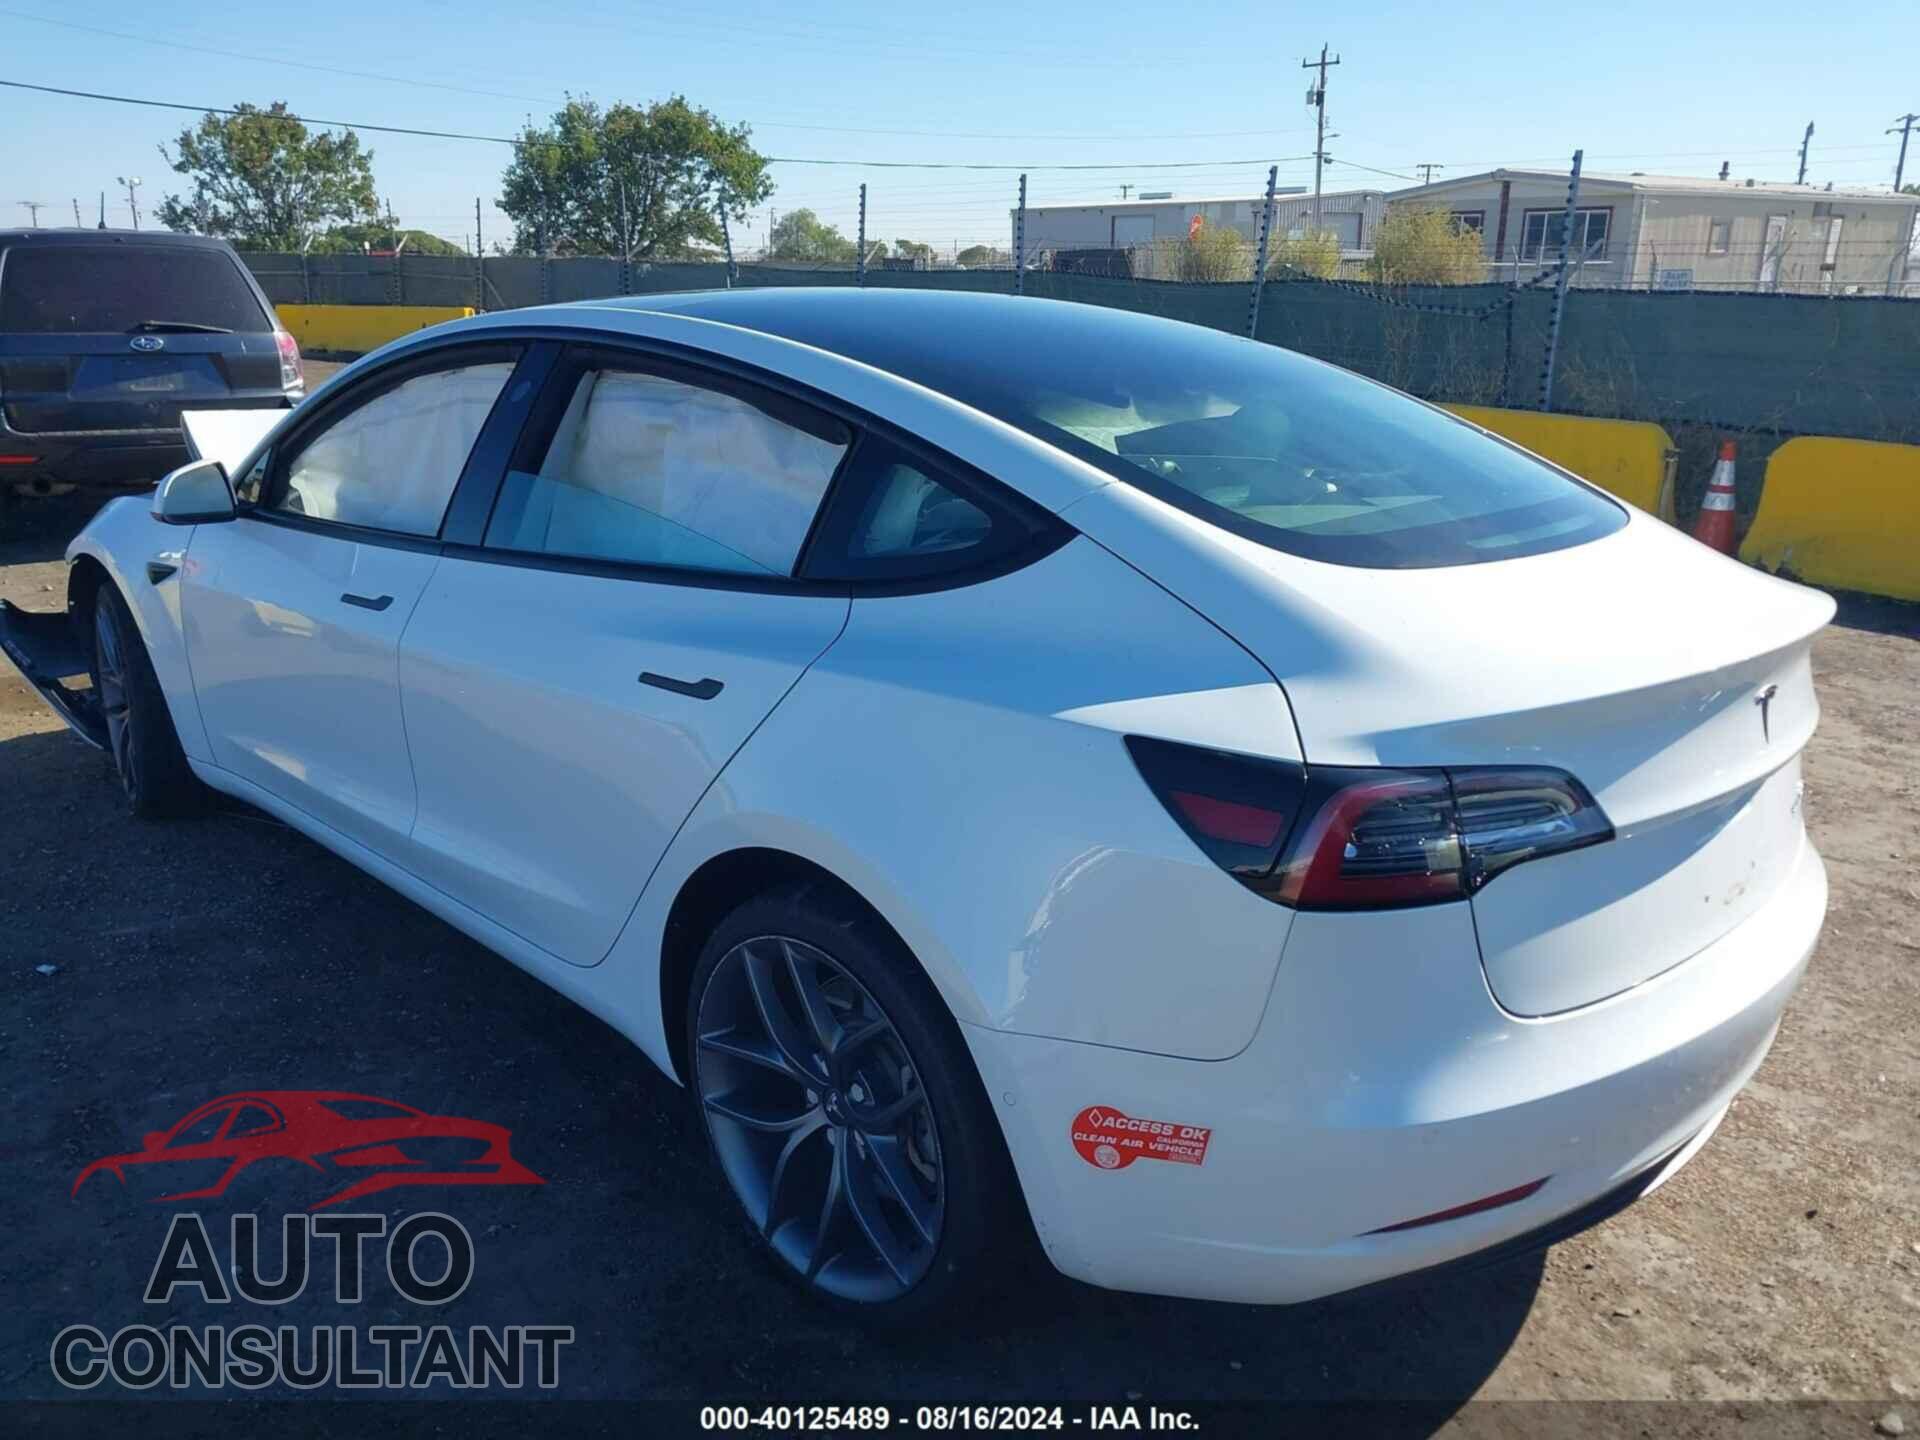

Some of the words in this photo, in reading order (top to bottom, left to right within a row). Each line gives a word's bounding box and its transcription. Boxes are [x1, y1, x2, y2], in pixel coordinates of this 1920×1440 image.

[1103, 1116, 1174, 1136] ACCESS
[1180, 1127, 1207, 1140] OK
[1073, 1132, 1117, 1144] CLEAN
[1120, 1138, 1144, 1149] AIR
[1148, 1142, 1203, 1156] VEHICLE
[1156, 1136, 1204, 1148] CALIFORNIA
